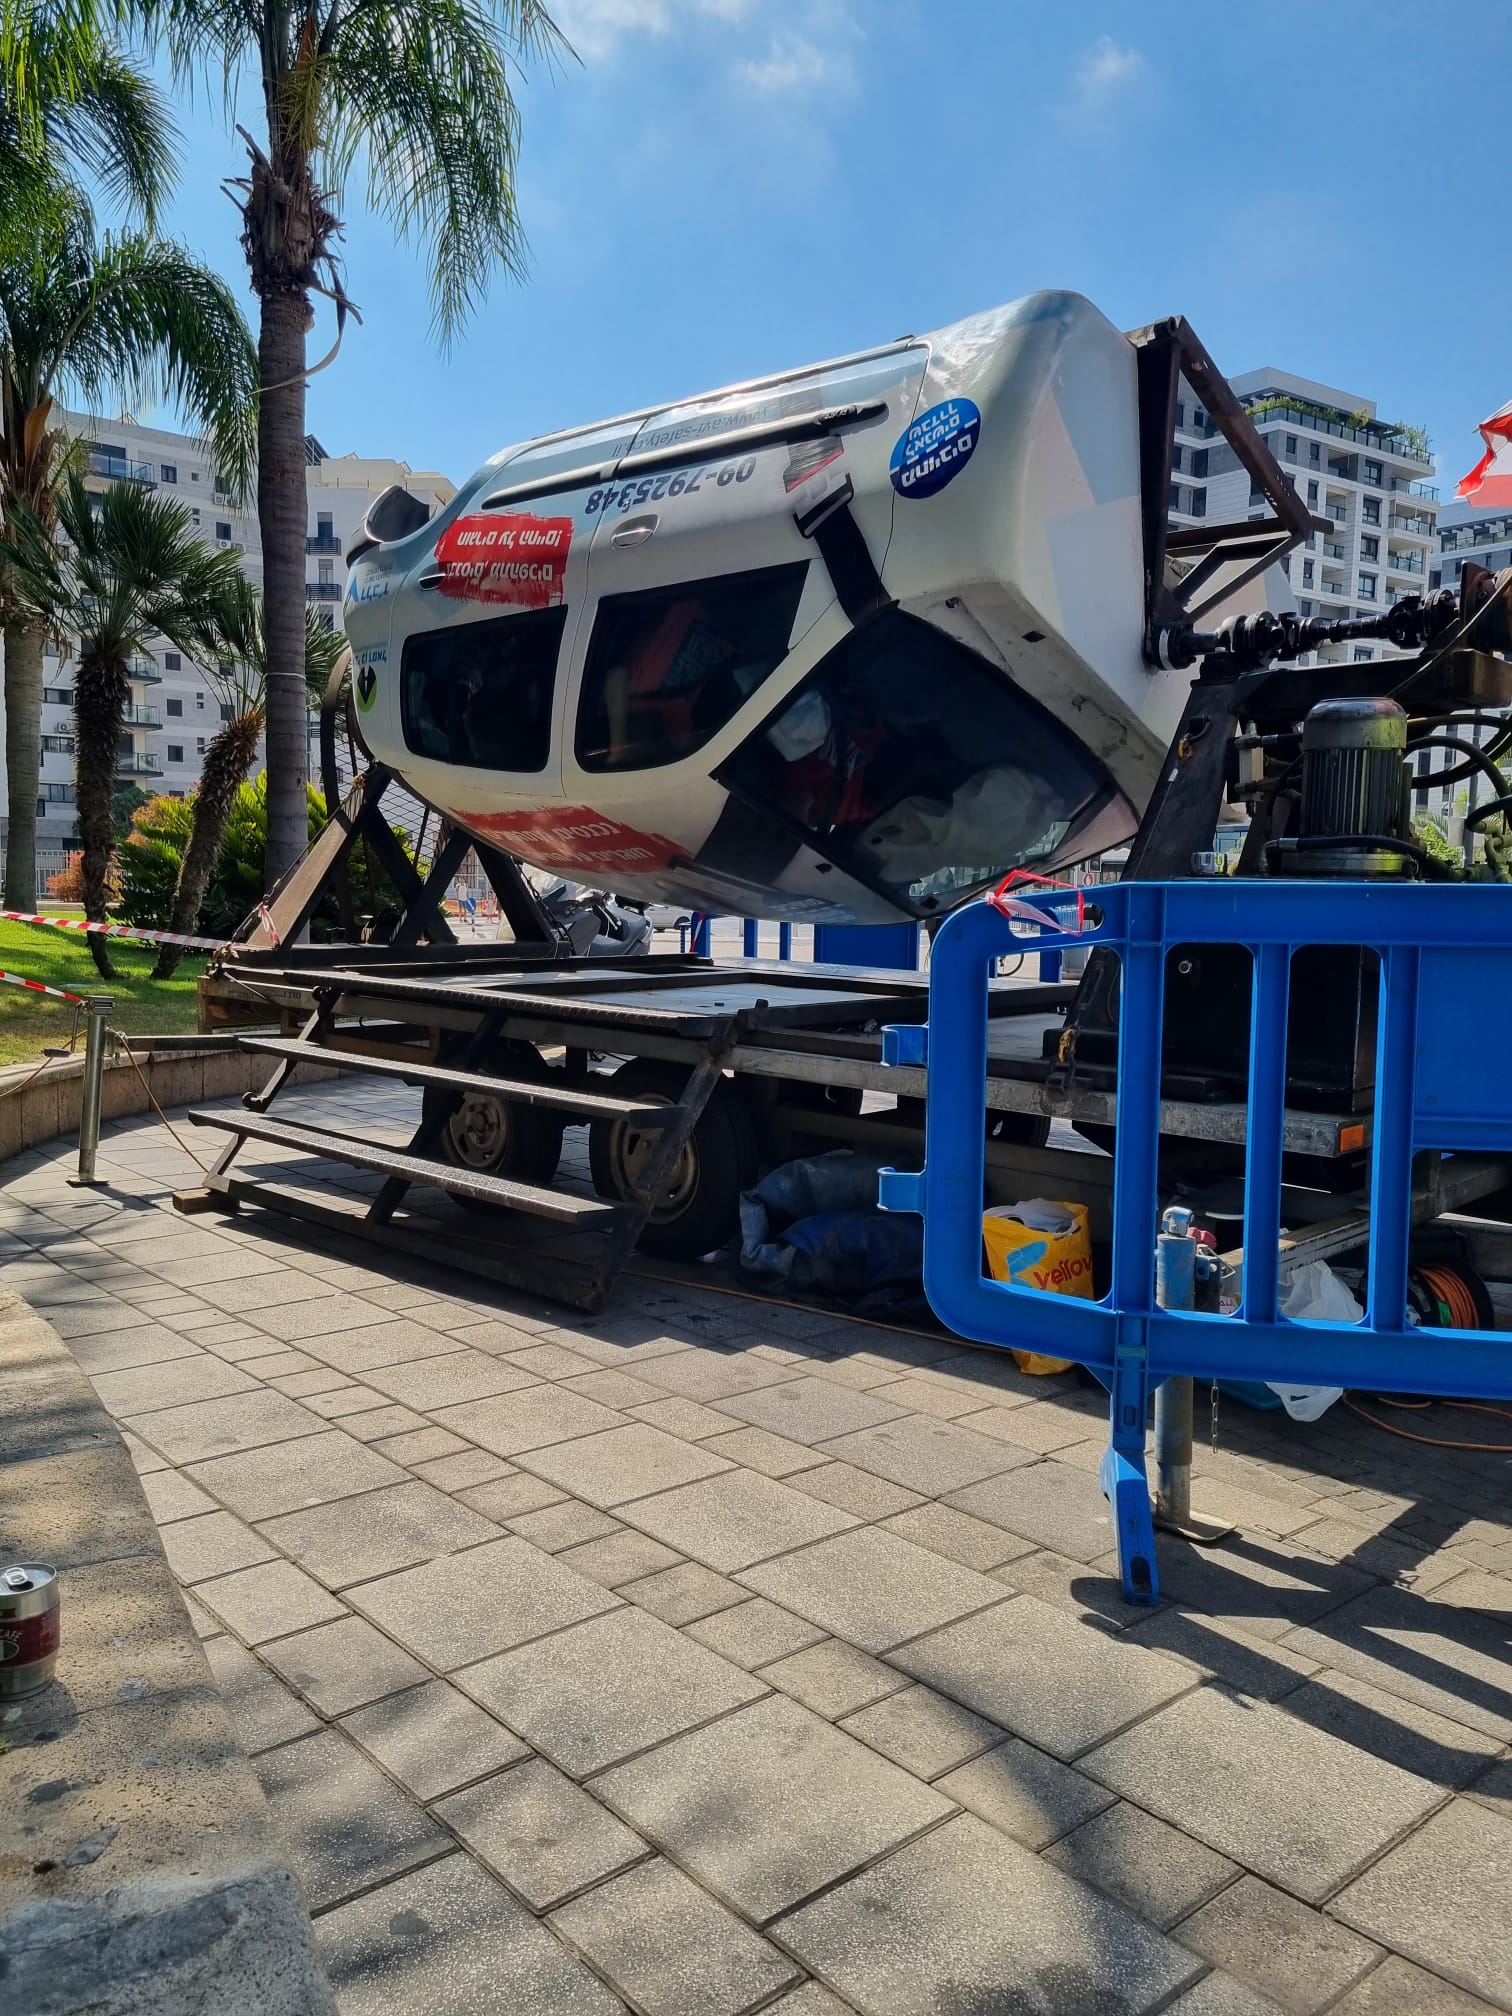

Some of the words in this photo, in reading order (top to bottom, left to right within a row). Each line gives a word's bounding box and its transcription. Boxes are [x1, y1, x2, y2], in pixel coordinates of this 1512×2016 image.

[611, 407, 768, 457] www.avi-safety.co.il
[904, 414, 960, 456] לאנשים
[908, 402, 958, 440] שבדרך
[901, 433, 972, 488] מחויבים
[585, 457, 757, 515] 09-7925348
[456, 530, 498, 546] חוגרים
[498, 531, 517, 549] על
[519, 530, 563, 547] החיים!
[490, 562, 553, 582] מתהפכים
